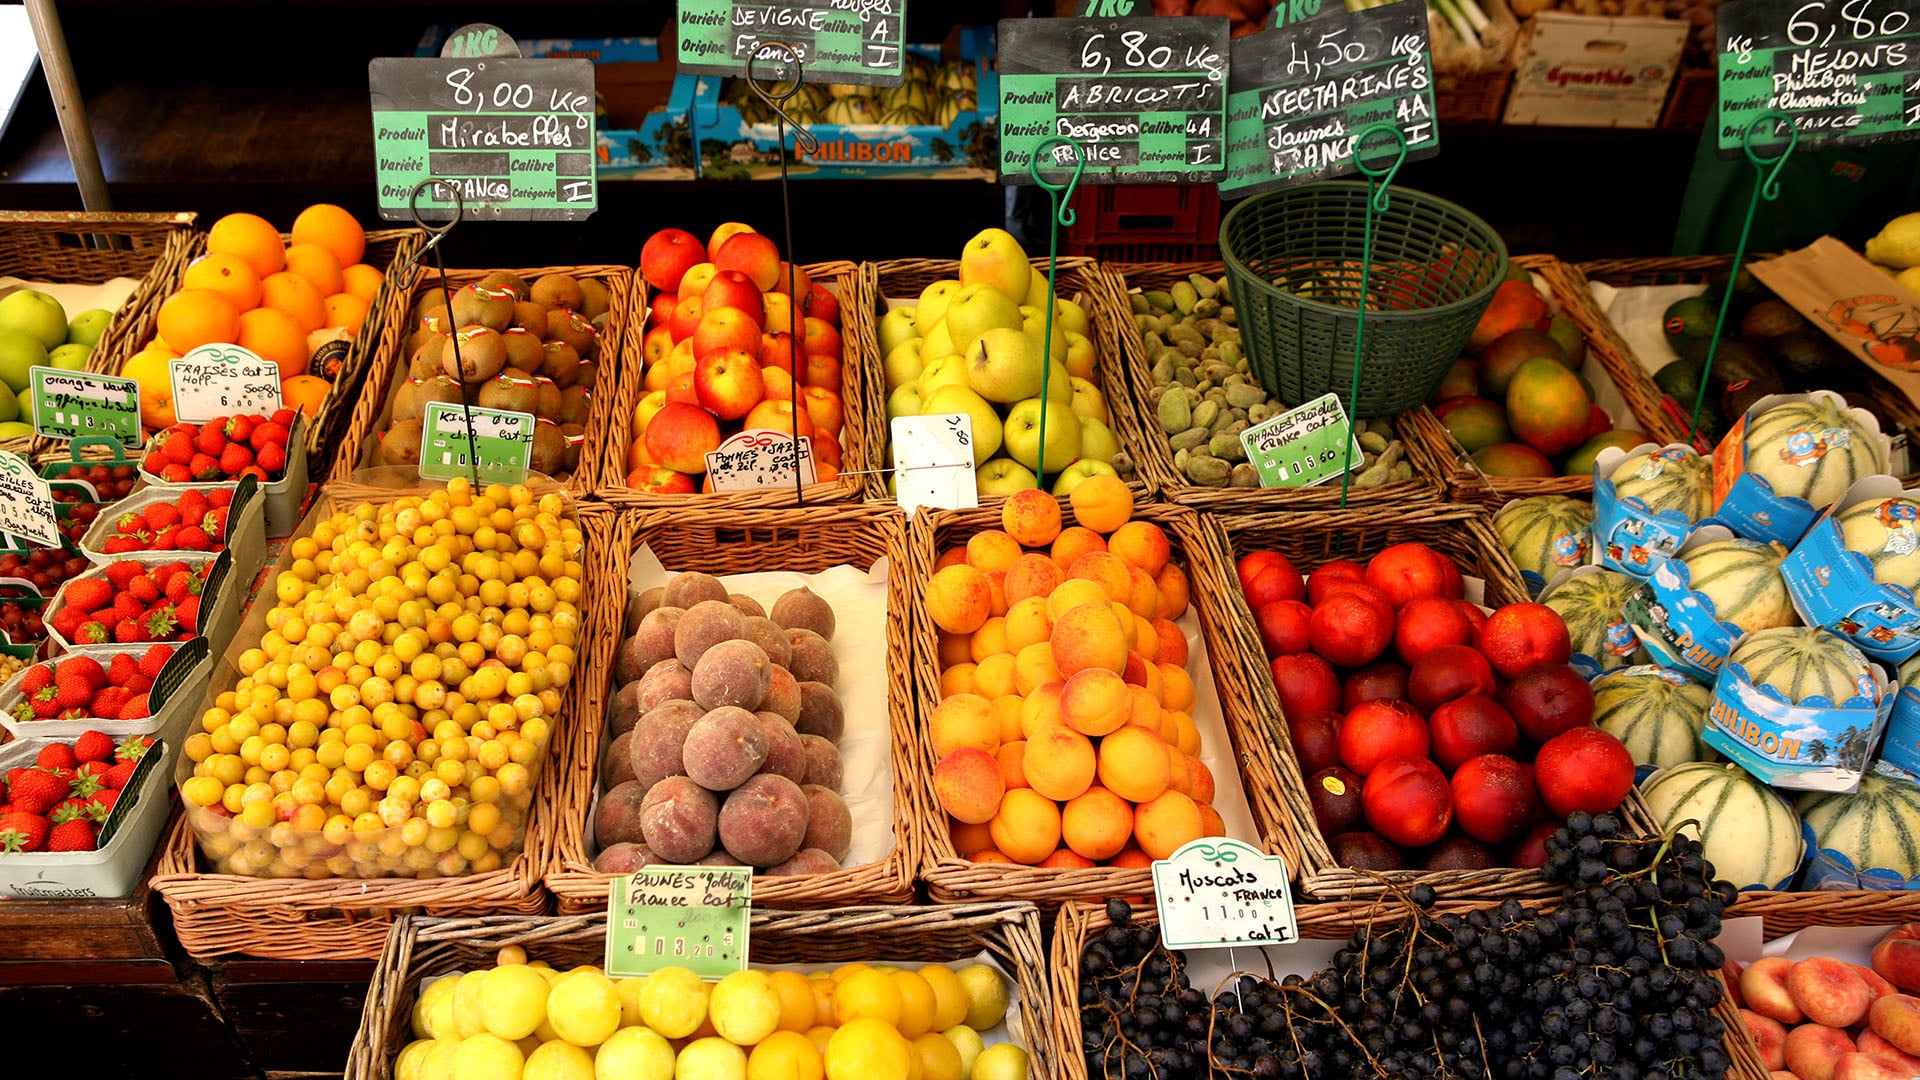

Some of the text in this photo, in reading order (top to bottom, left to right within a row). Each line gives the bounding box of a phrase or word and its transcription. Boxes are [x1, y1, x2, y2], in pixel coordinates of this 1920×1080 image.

[682, 10, 726, 27] Variété
[871, 19, 889, 43] A
[1787, 0, 1910, 48] 6,80
[453, 28, 498, 58] 1KG
[682, 38, 725, 55] Origine
[867, 45, 898, 67] I
[1081, 31, 1172, 76] 6,80
[1287, 27, 1365, 81] 4,50
[1723, 43, 1908, 81] Produit MELONS
[446, 68, 534, 114] 8,00
[1004, 83, 1212, 110] Produit ABRICOTS
[1228, 64, 1430, 123] oduit NECTARINES
[1723, 96, 1769, 112] Variété
[1349, 110, 1392, 127] Calibre
[1396, 94, 1429, 122] 4A
[378, 114, 572, 148] Produit Mirabelles
[1004, 117, 1211, 143] Variété Bergeron Calibre 4A
[1403, 122, 1431, 145] I
[380, 155, 554, 172] Variété Calibre
[1140, 150, 1185, 165] Catégorie
[1190, 144, 1211, 165] I
[512, 186, 556, 200] Catégorie
[563, 181, 593, 202] I
[175, 364, 238, 378] FRAISES
[9, 883, 97, 898] fruitmasters
[1179, 867, 1258, 895] Muscats
[1274, 926, 1290, 942] I
